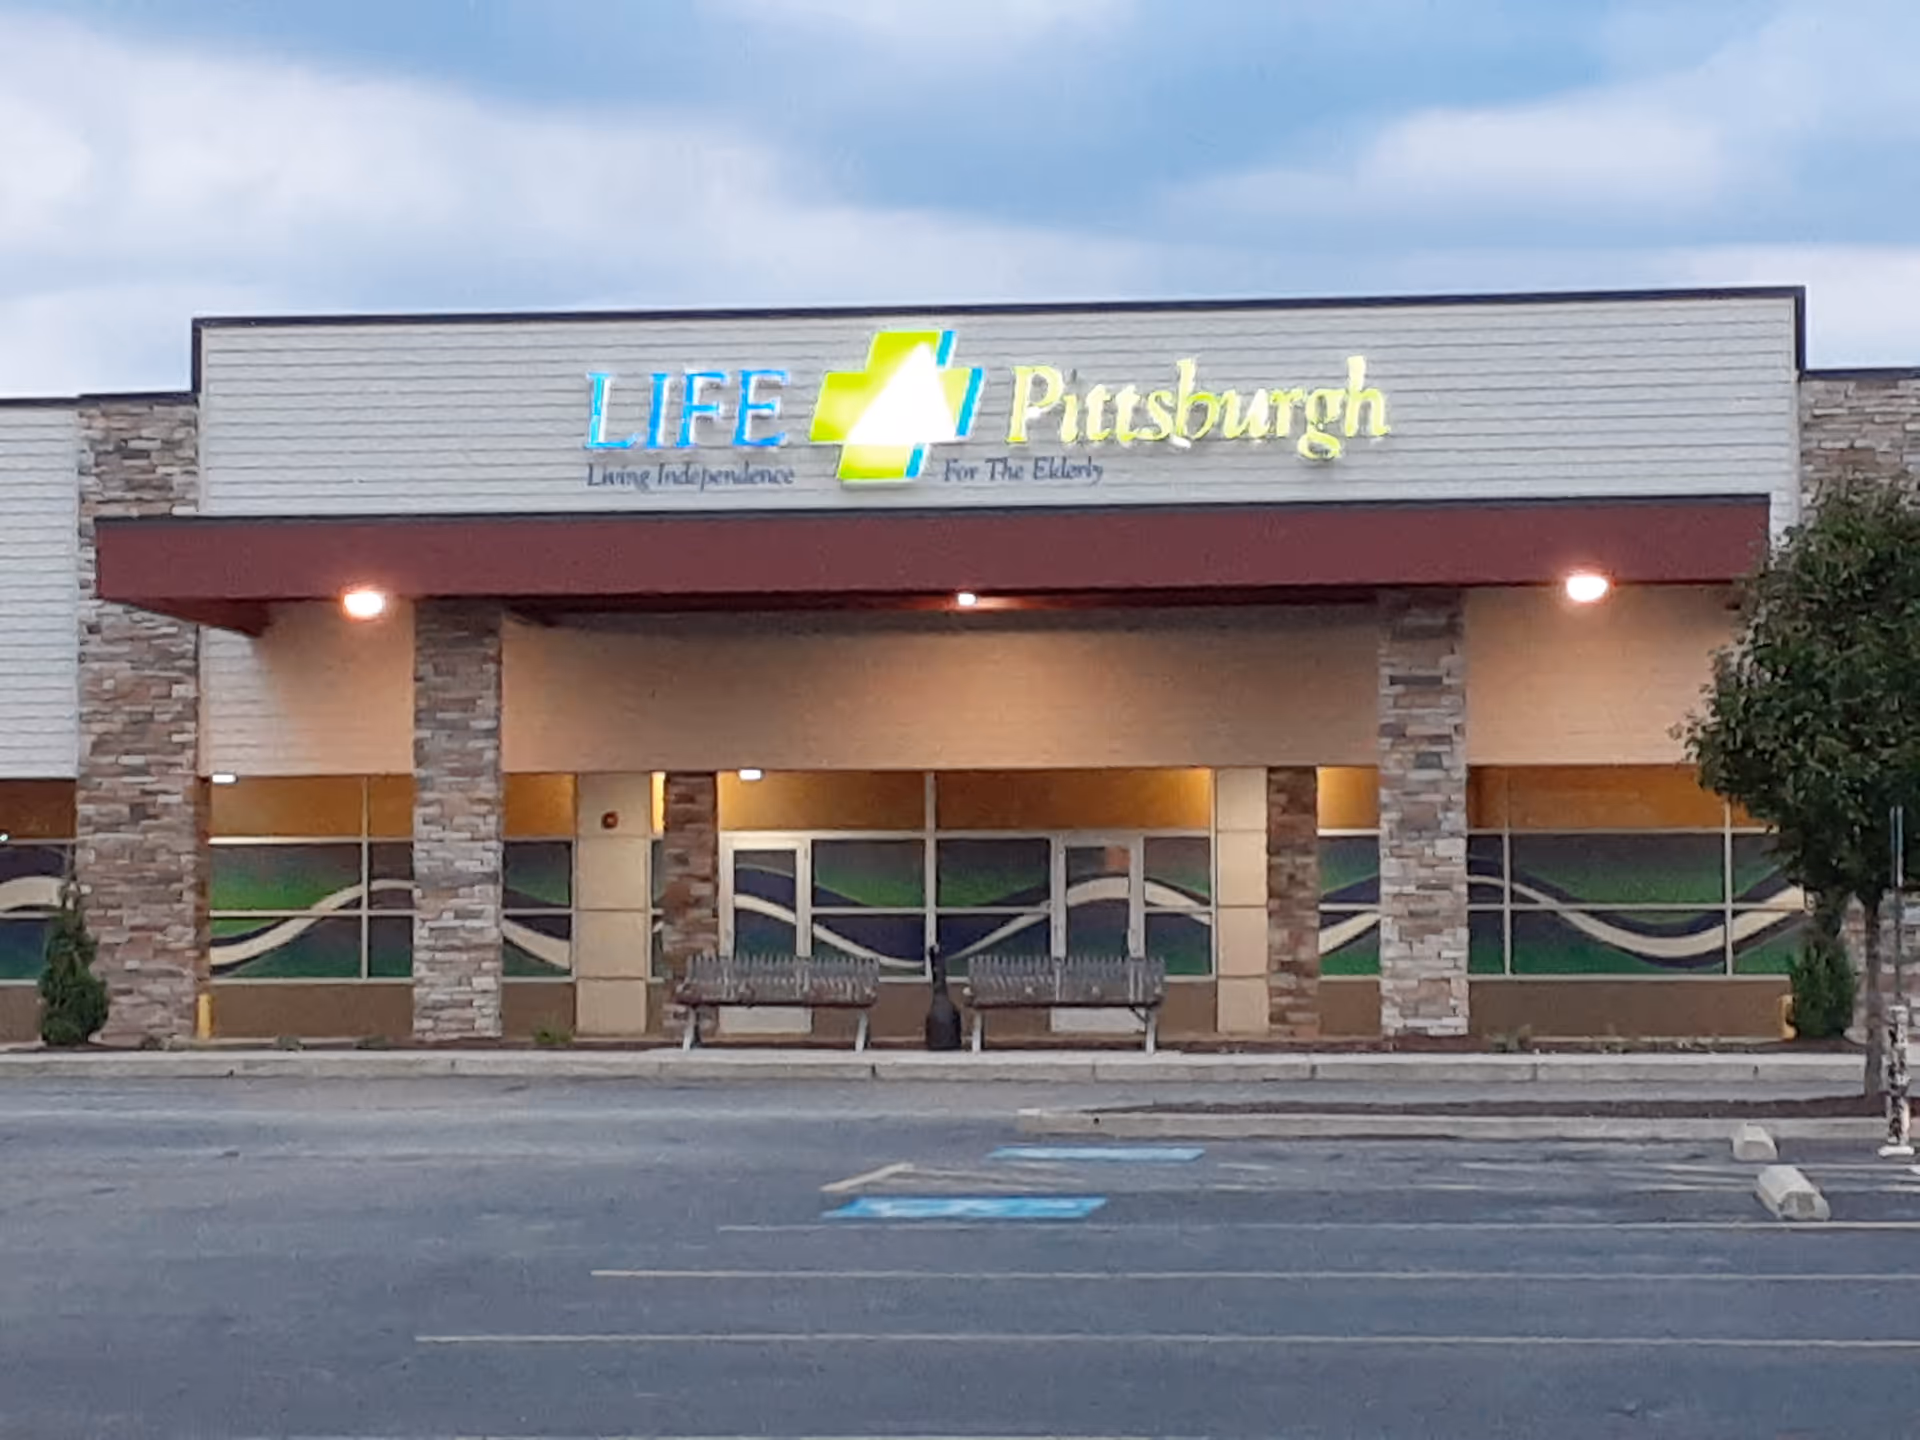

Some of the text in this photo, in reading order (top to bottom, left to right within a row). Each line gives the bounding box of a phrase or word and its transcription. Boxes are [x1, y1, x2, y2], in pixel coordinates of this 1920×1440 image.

[585, 355, 1390, 461] LIFE Pittsburgh
[587, 461, 796, 492] Living Independence
[944, 455, 1105, 487] For The Elderly
